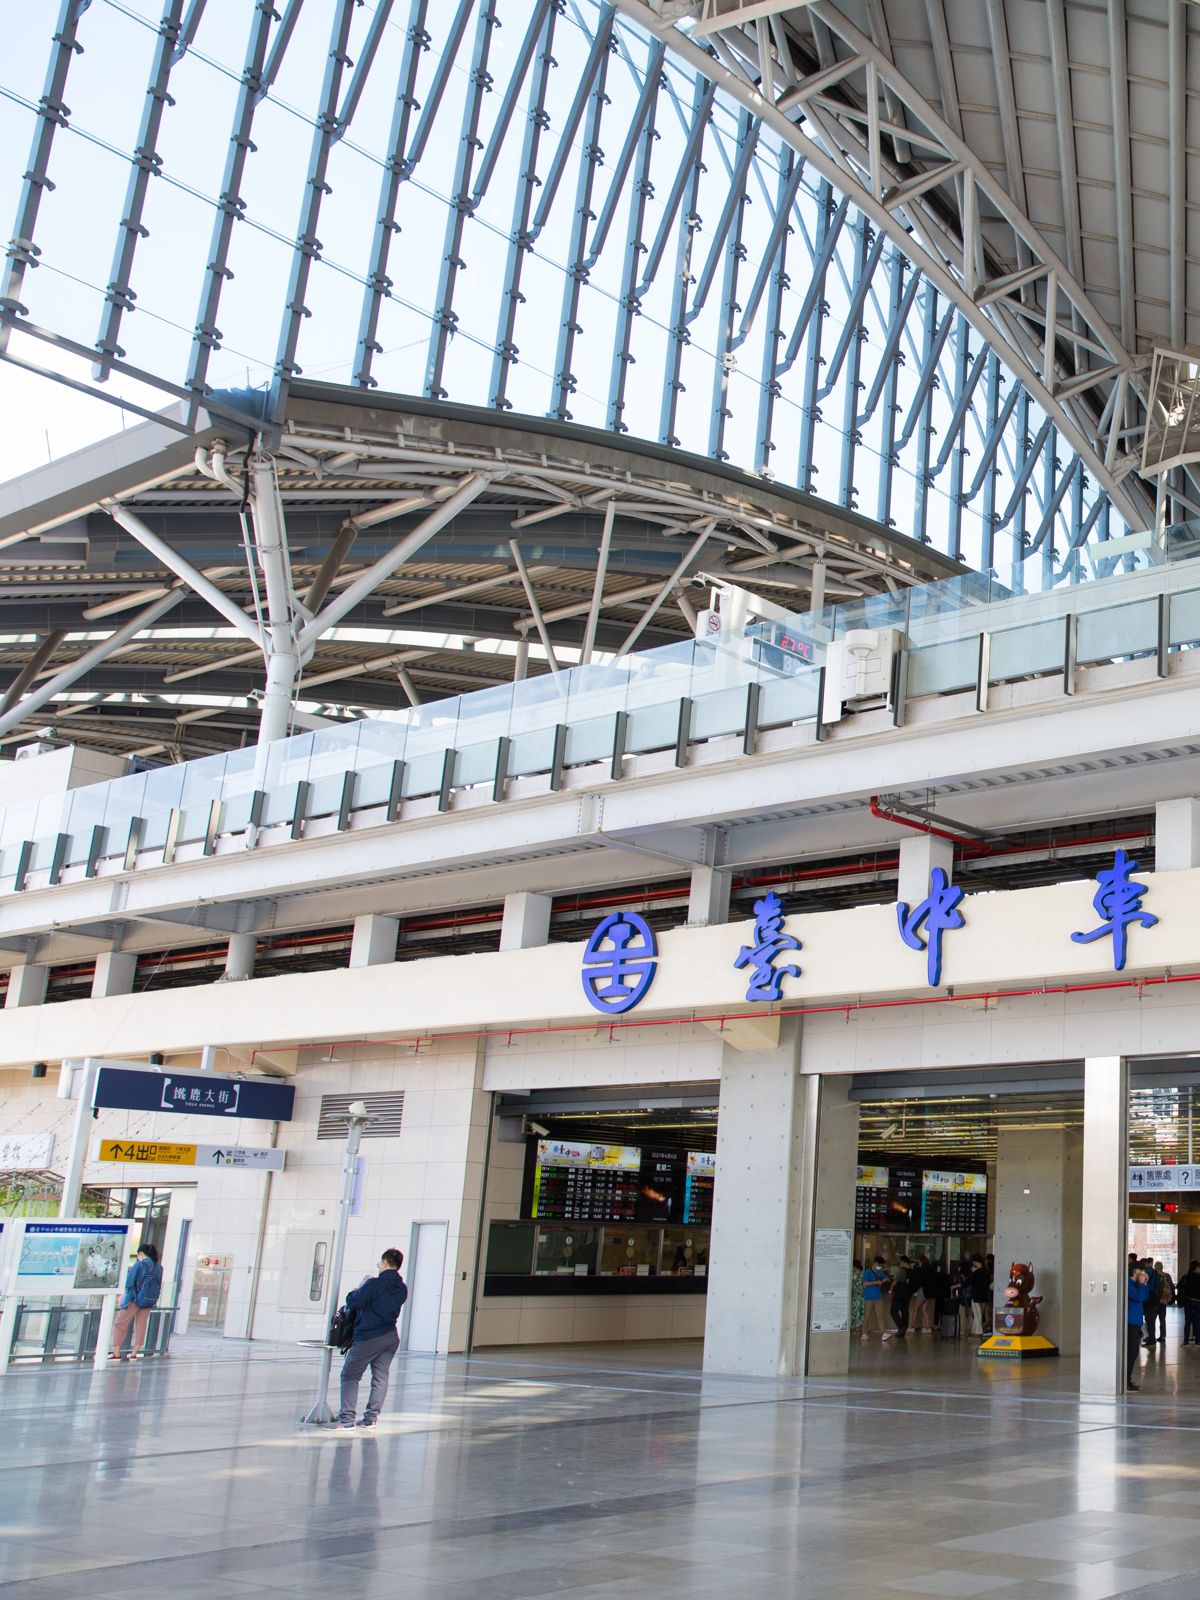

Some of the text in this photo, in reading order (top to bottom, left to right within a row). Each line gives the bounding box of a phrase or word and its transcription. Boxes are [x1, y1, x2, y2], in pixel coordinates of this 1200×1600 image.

[173, 1087, 229, 1103] 鐵鹿大街
[1146, 1170, 1172, 1180] 售票處
